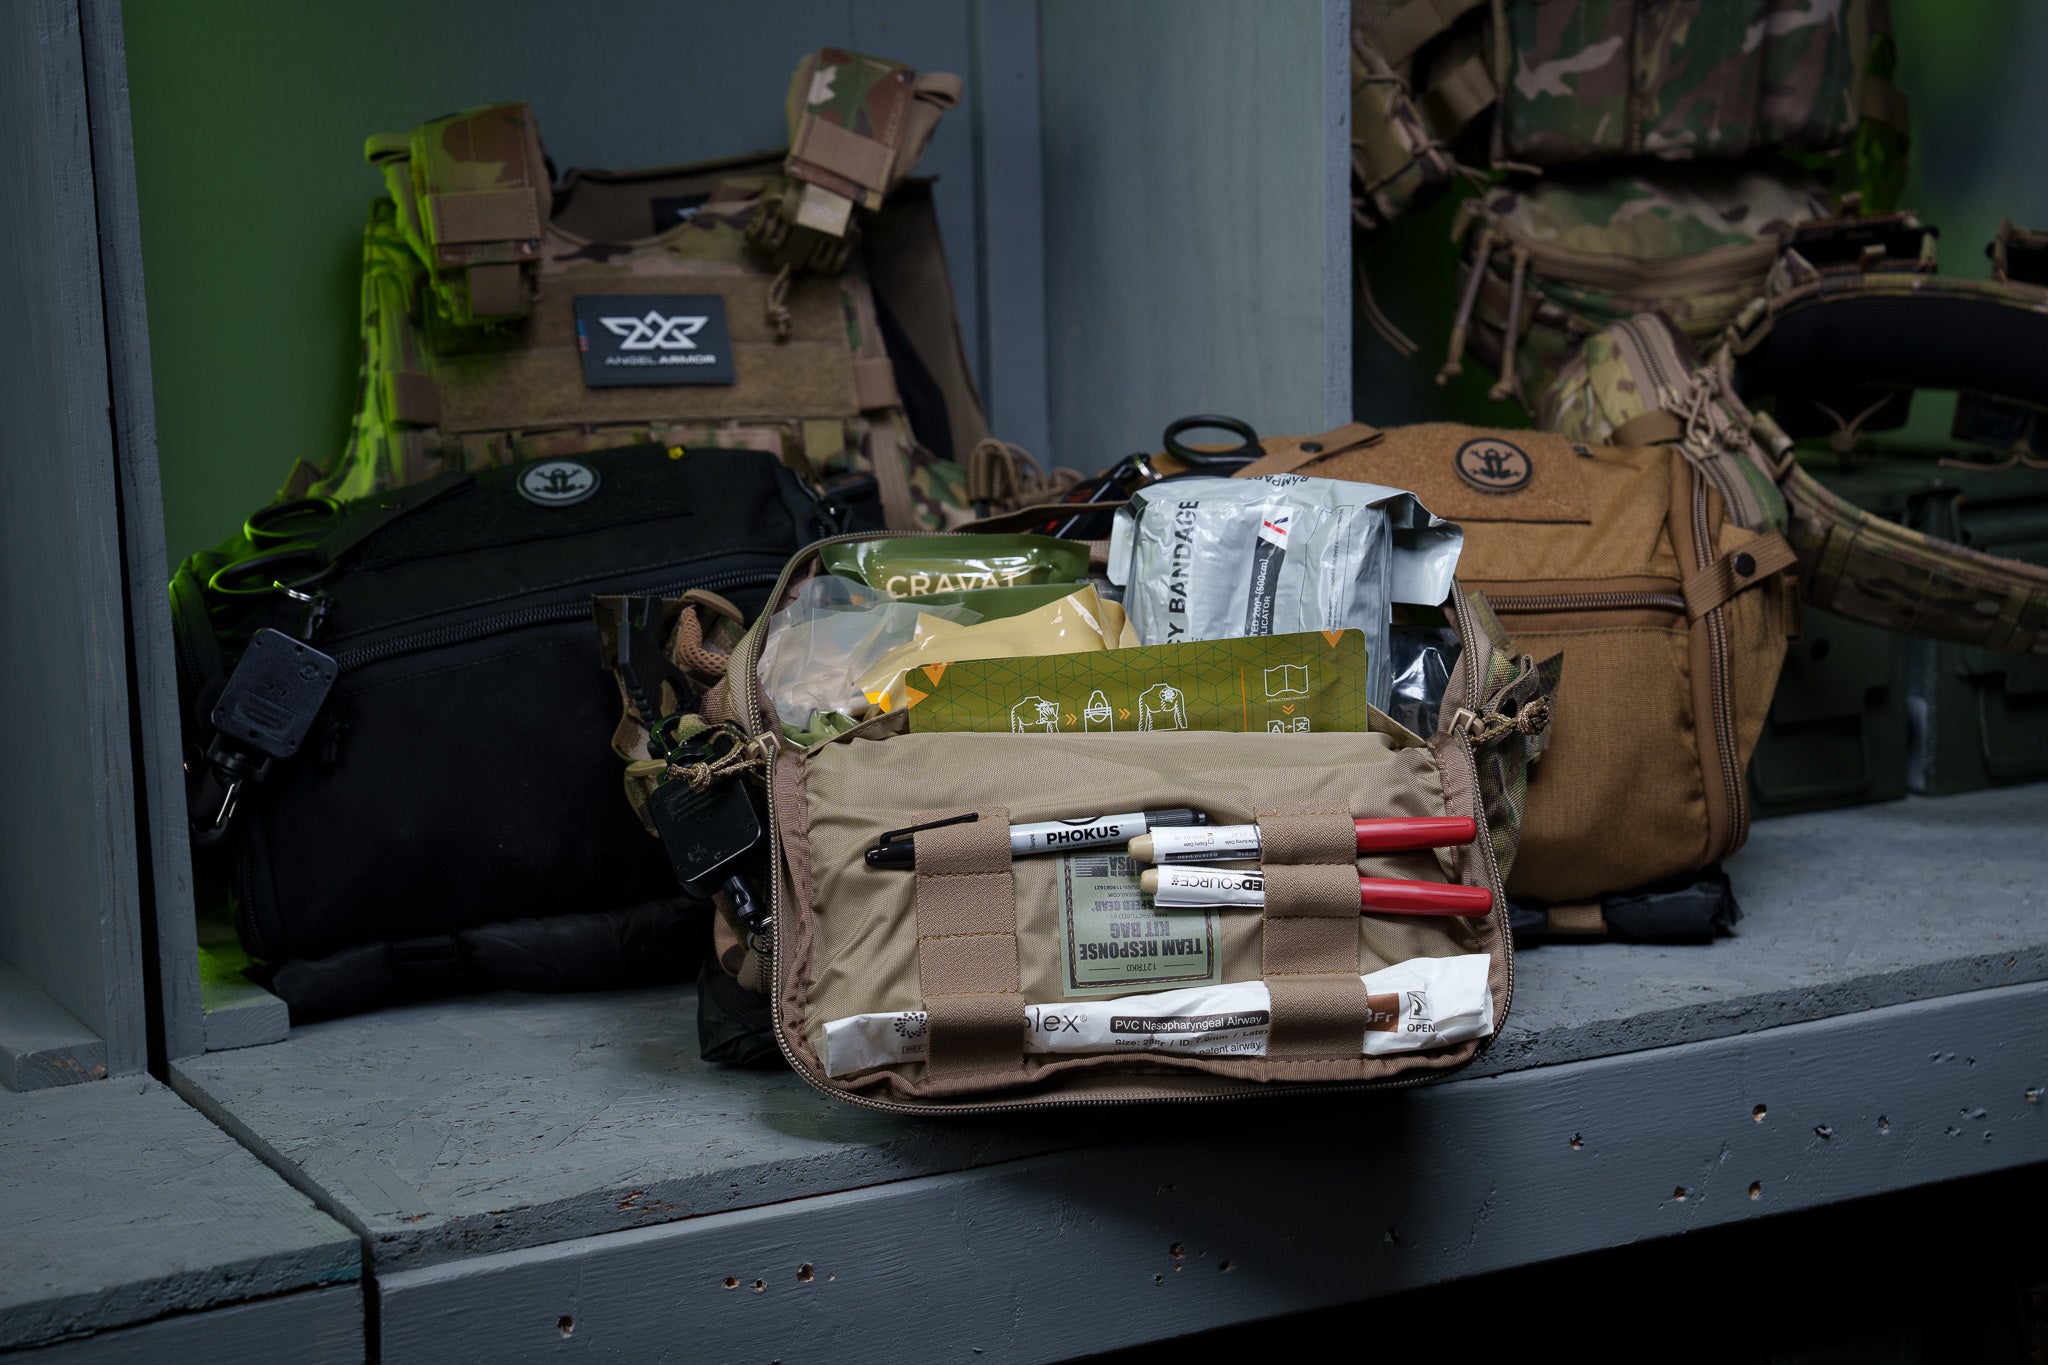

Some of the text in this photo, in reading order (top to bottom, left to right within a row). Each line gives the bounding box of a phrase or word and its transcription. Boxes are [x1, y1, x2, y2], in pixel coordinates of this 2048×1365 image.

[605, 354, 717, 366] ANGEL ARMOR
[1168, 501, 1199, 613] BANDAGE
[886, 571, 1020, 599] CRAVAT
[1260, 595, 1271, 636] LICATOR
[1108, 856, 1135, 871] USA
[1109, 920, 1170, 939] KIT BAG
[1079, 938, 1204, 960] TEAM RESPONSE
[1115, 1015, 1263, 1032] PVC Nasopharyngeal Airway
[1406, 1023, 1436, 1033] OPEN
[1230, 1041, 1262, 1053] airway
